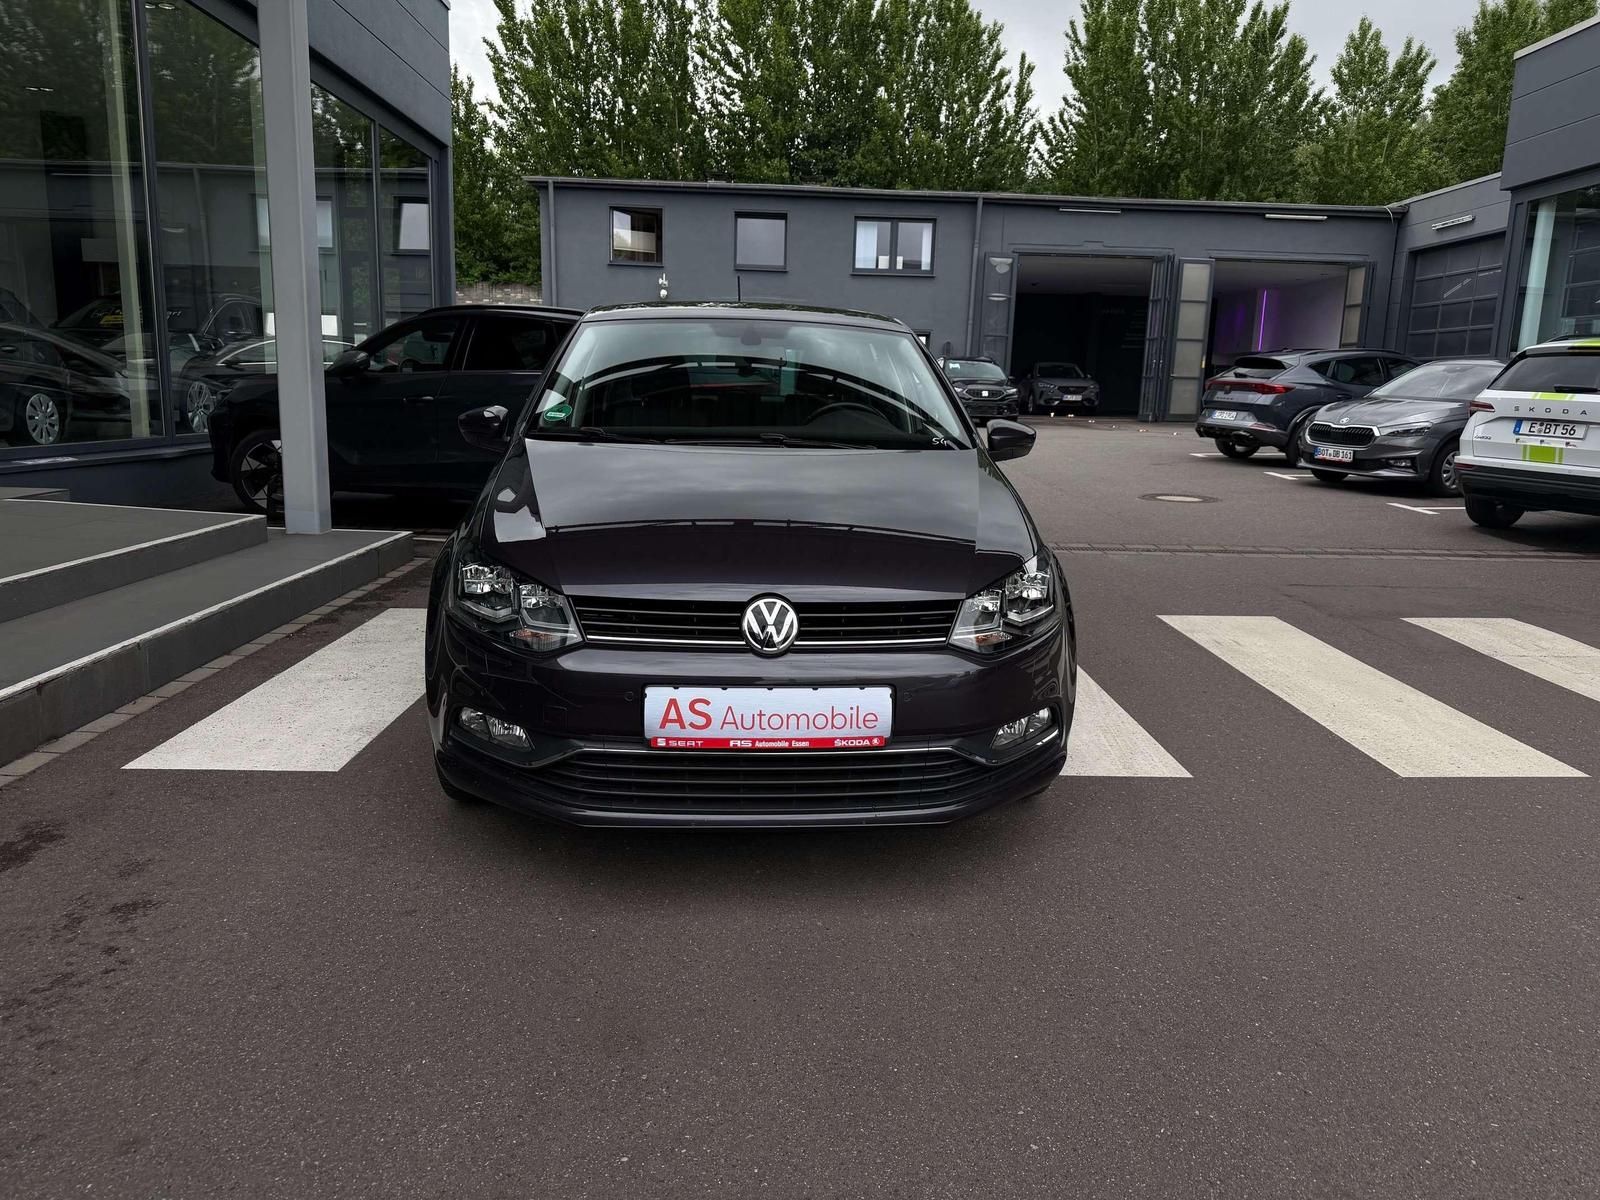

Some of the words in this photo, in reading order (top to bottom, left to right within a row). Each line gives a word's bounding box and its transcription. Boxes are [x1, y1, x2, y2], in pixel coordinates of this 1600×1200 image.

[1529, 422, 1537, 433] E
[1544, 423, 1560, 434] BT
[1561, 424, 1576, 436] 56
[1341, 450, 1352, 459] 161
[659, 697, 712, 730] AS
[720, 705, 878, 730] Automobile
